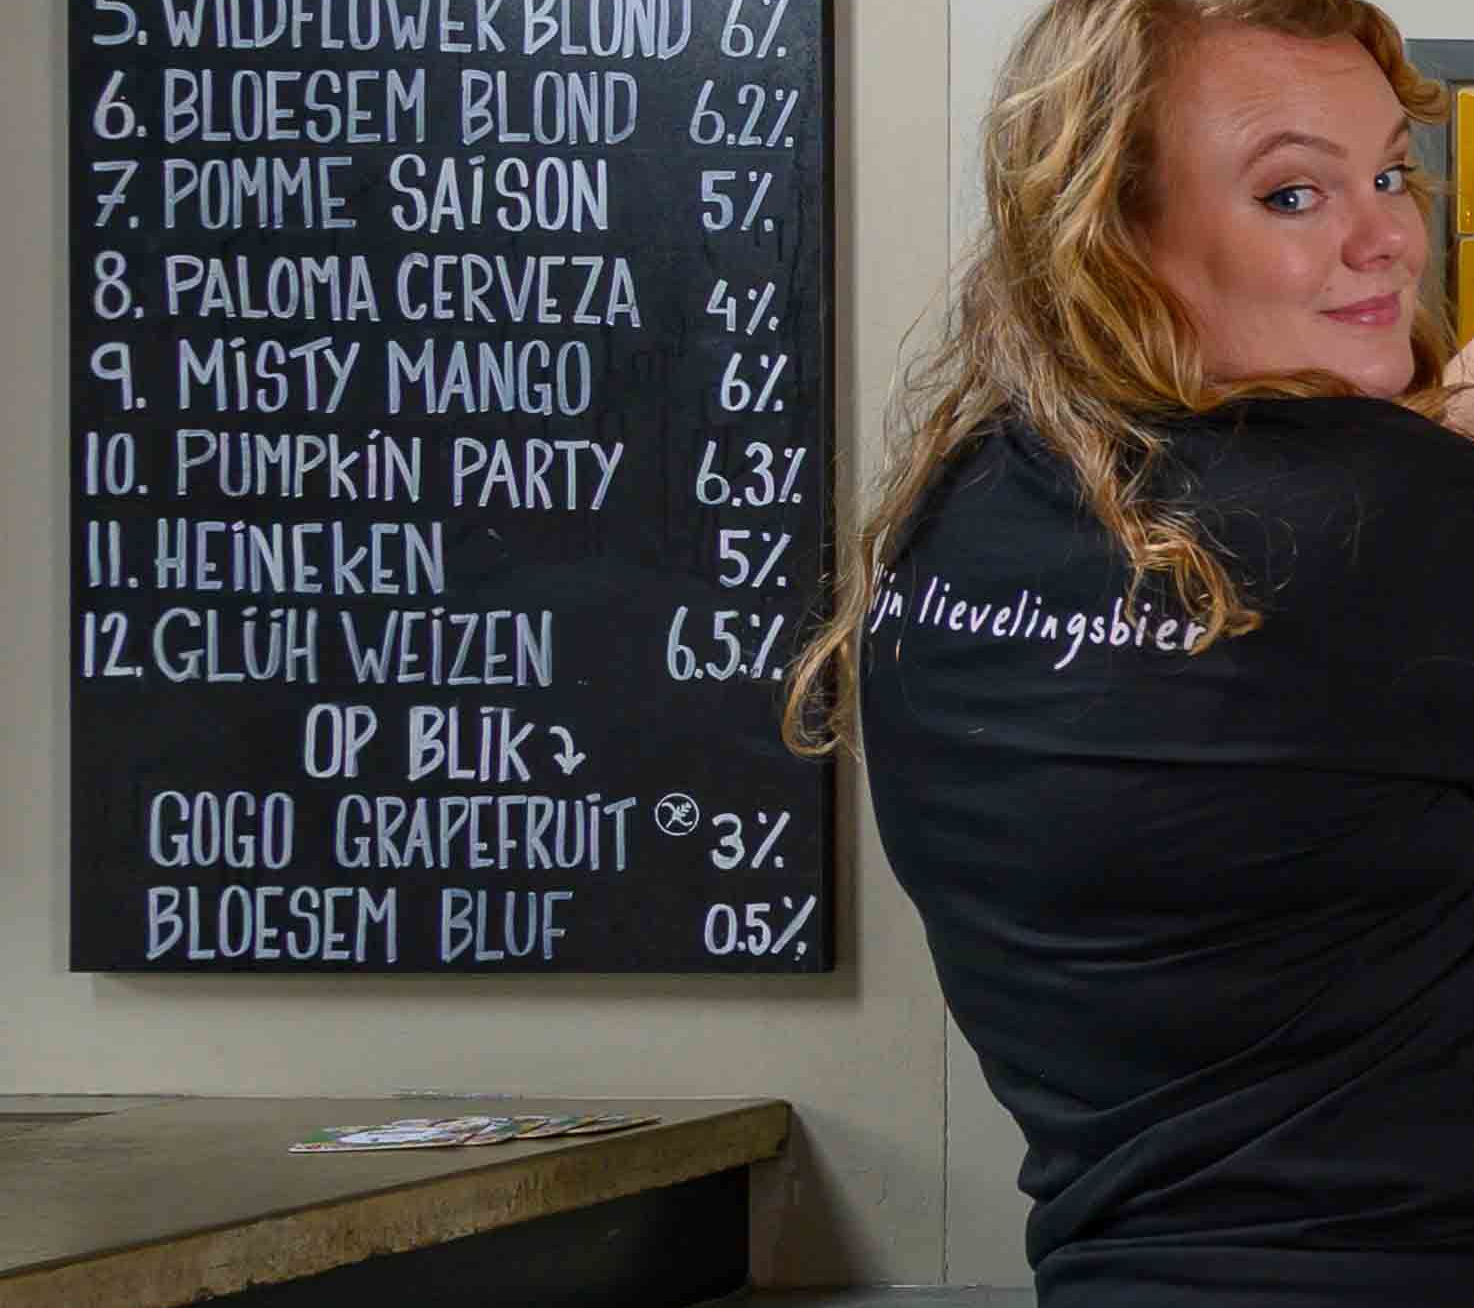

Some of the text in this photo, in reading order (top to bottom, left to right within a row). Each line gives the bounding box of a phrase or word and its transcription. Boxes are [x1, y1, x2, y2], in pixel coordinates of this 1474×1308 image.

[93, 69, 798, 147] 6. BLOESEM BLOND 6.2%
[92, 154, 773, 233] 7. POMME SAISON 5%
[165, 255, 380, 322] PALOMA
[398, 252, 641, 327] CERVEZA
[706, 279, 779, 335] 4%
[91, 337, 787, 416] 9. MISTY MANGO 6%
[87, 429, 806, 510] 10. PUMPKIN PARTY 6.3%
[88, 518, 792, 595] 11. HEINEKEN 5%
[84, 612, 143, 677] 12.
[342, 609, 552, 687] WEIZEN
[918, 575, 1207, 670] lievelingsbier
[304, 703, 532, 781] OP BLIK
[149, 791, 790, 871] GOGO GRAPEFRUIT 3%
[146, 886, 816, 963] BLOESEM BLUF 0.5%
